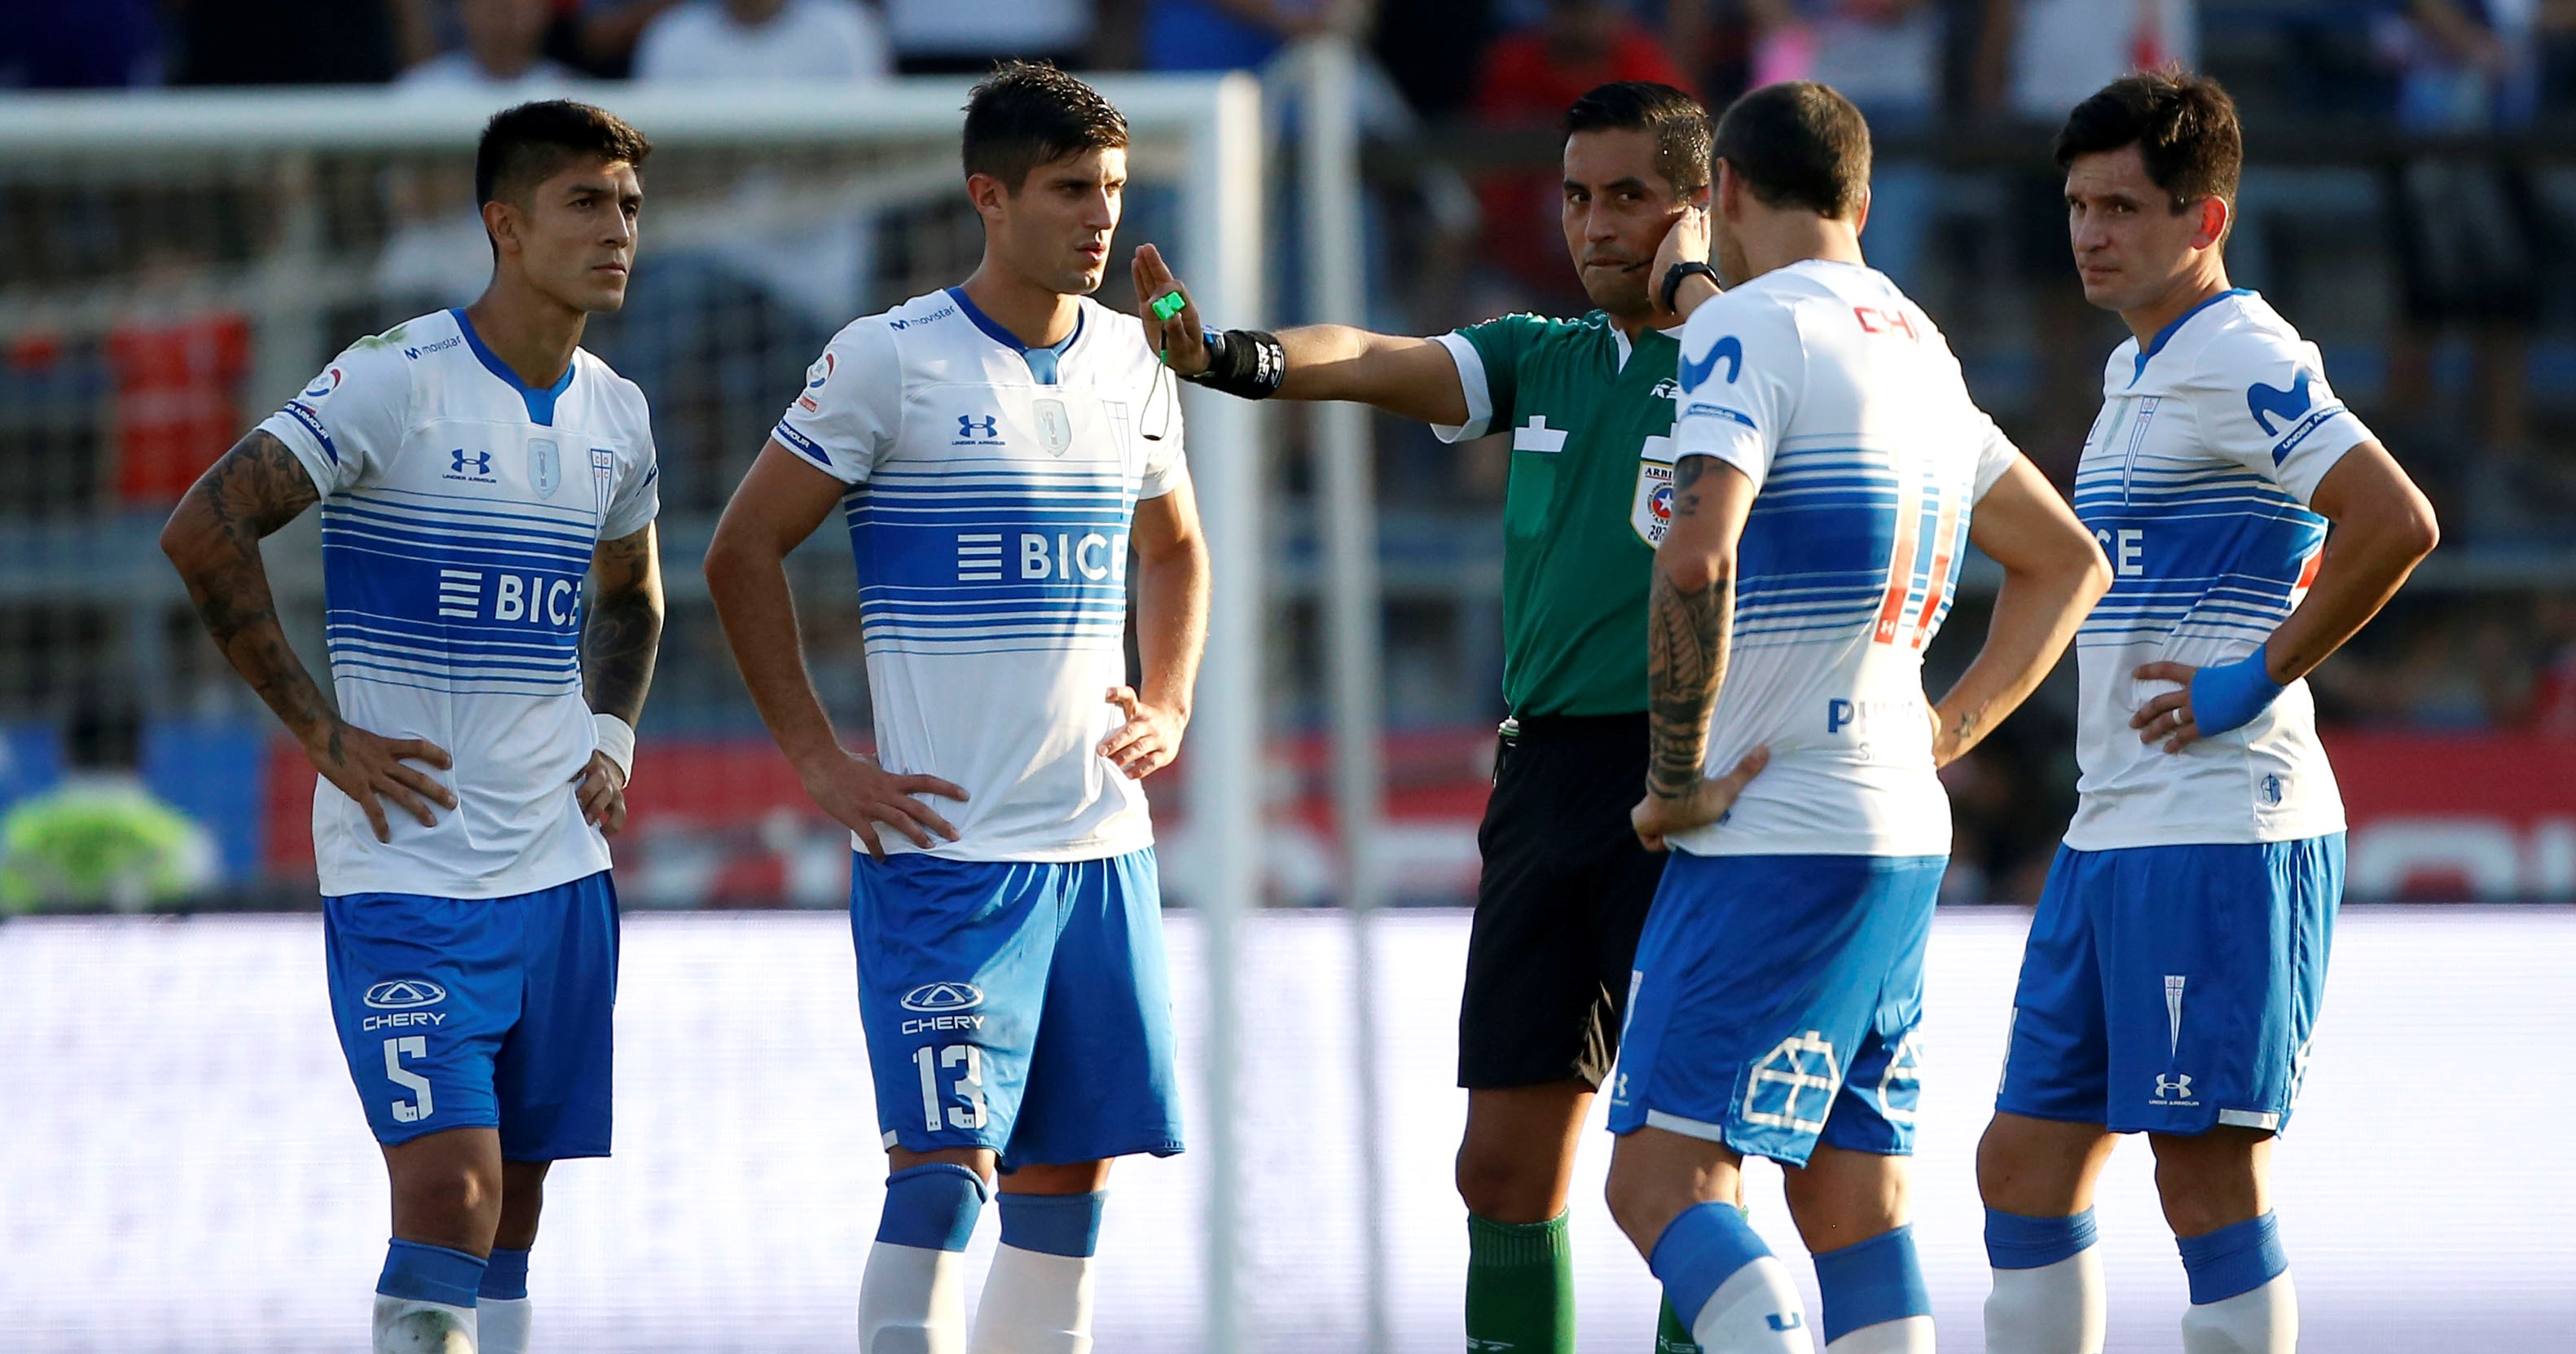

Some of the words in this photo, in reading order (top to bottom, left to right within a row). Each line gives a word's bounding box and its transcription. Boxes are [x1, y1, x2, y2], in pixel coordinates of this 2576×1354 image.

[911, 305, 955, 326] movistar
[422, 336, 461, 355] movistar
[294, 407, 329, 440] ARMOUR
[2282, 422, 2314, 449] UNDER
[1021, 533, 1128, 581] BICE
[363, 1012, 446, 1031] CHERY
[902, 1016, 985, 1035] CHERY
[384, 1035, 433, 1123] 5
[912, 1044, 988, 1132] 13
